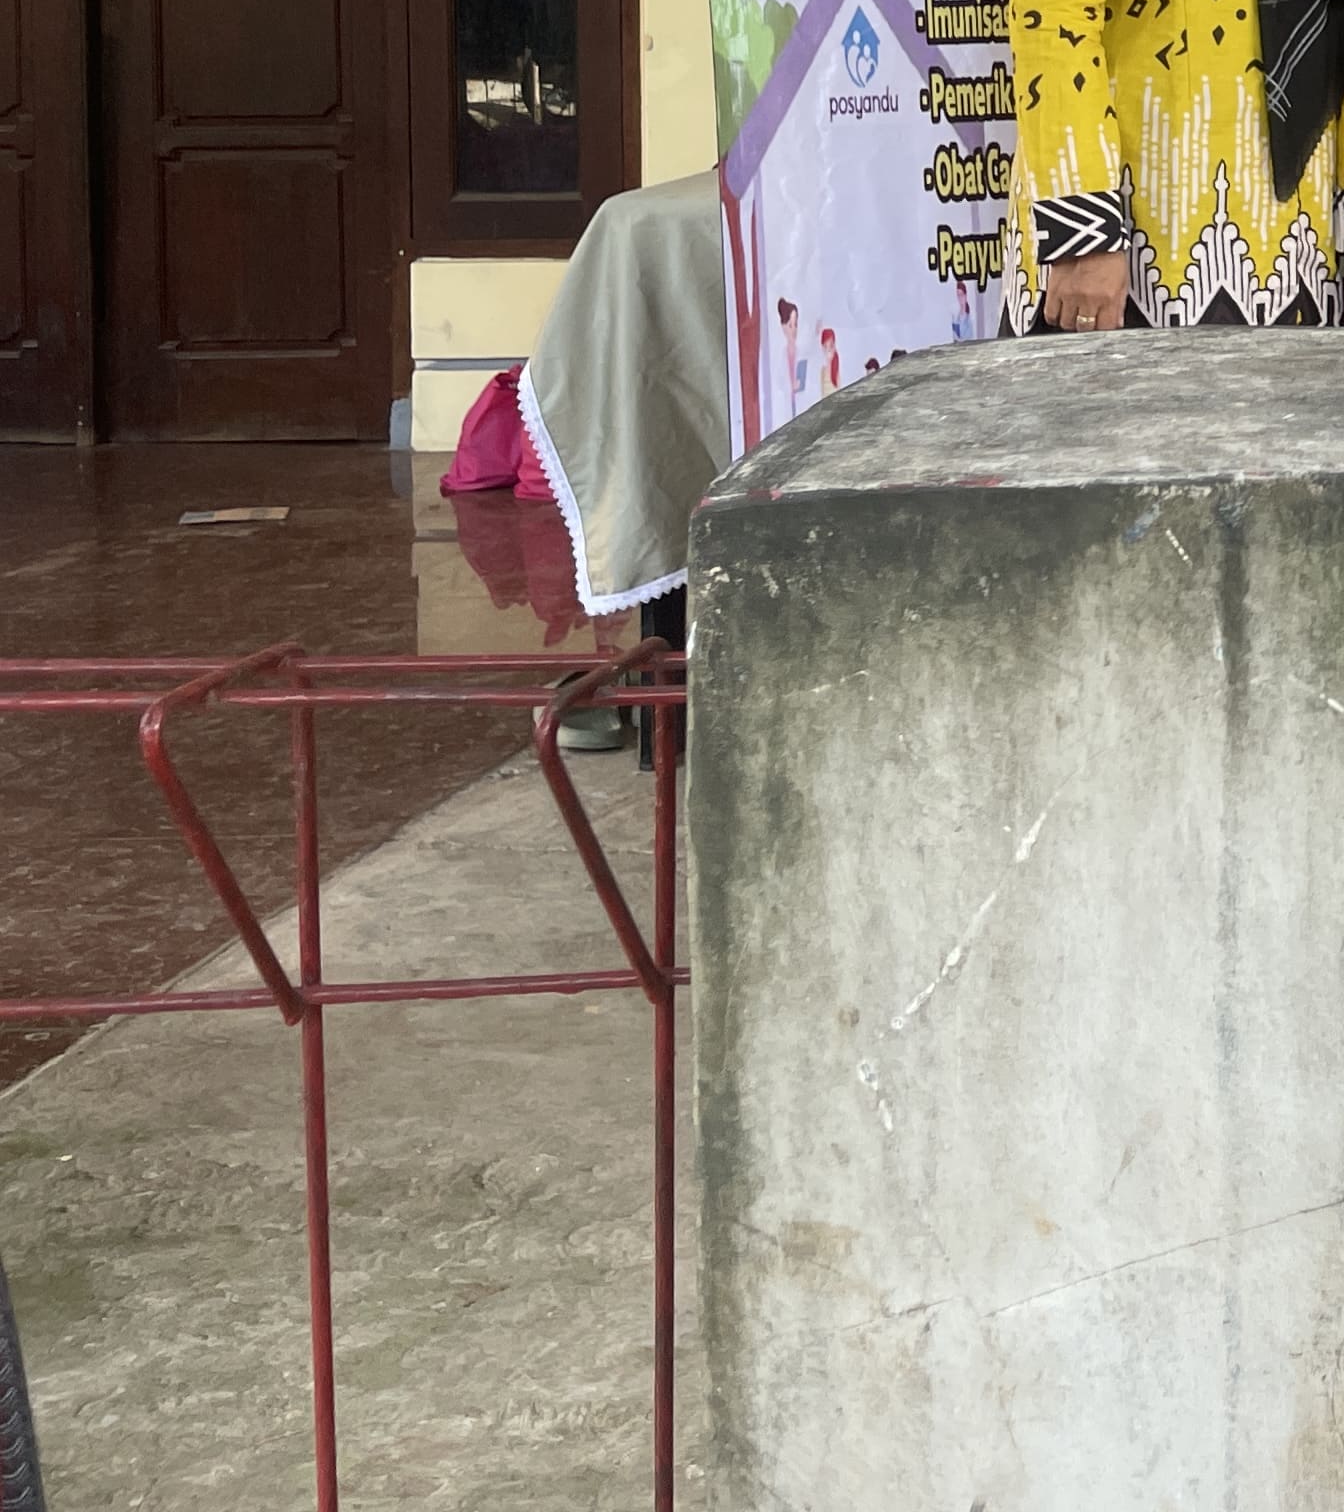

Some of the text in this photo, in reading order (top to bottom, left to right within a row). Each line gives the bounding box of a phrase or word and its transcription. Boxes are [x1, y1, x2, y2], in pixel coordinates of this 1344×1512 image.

[829, 85, 899, 122] posyandu
[934, 142, 1015, 204] Obat Ca
